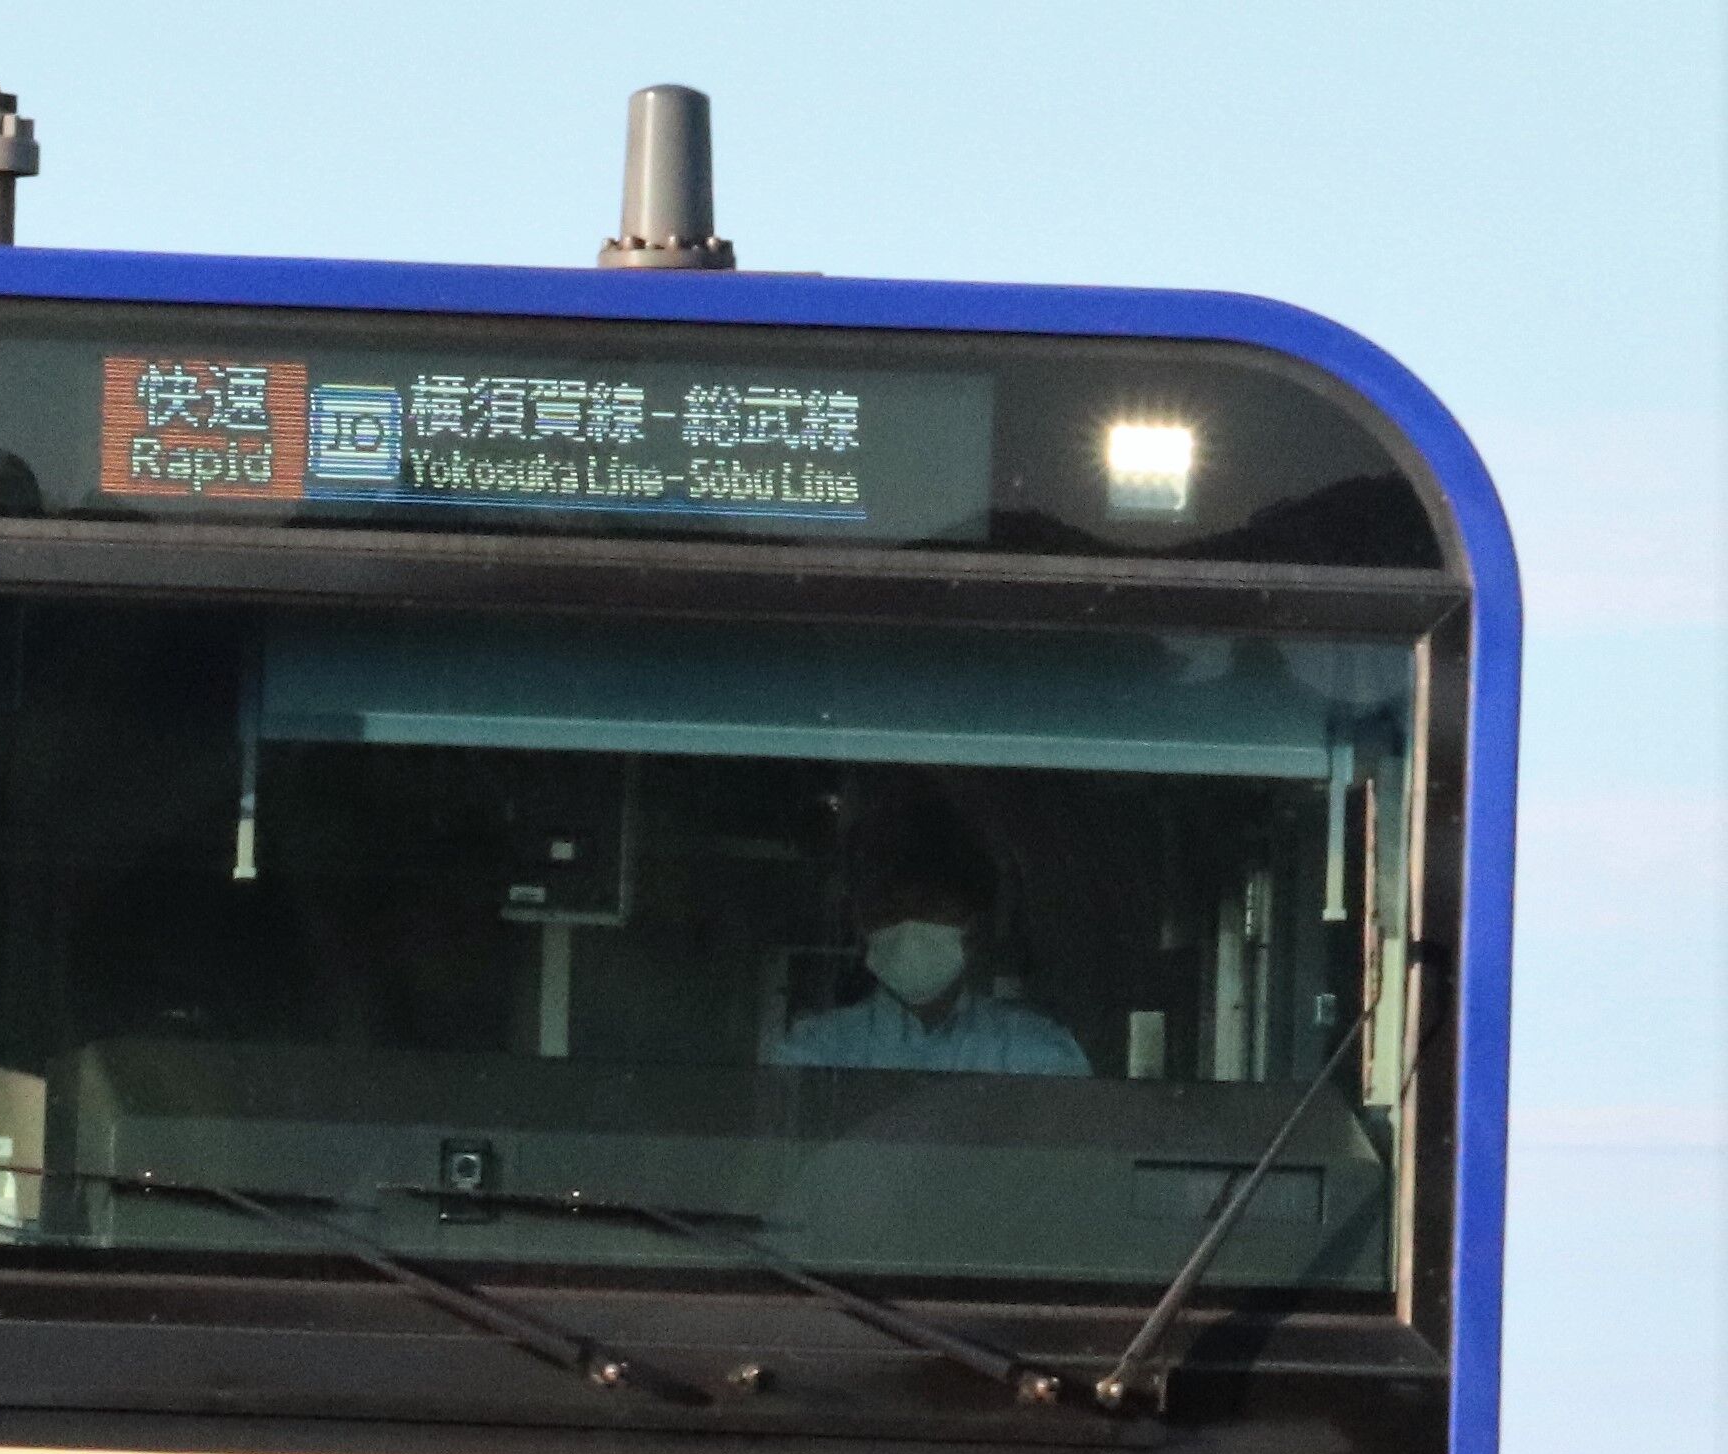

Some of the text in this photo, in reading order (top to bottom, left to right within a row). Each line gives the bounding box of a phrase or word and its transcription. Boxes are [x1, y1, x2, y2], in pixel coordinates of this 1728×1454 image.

[137, 364, 269, 430] 快速
[131, 437, 272, 491] Rapid
[409, 448, 580, 493] Yokosuka
[781, 461, 860, 504] Line
